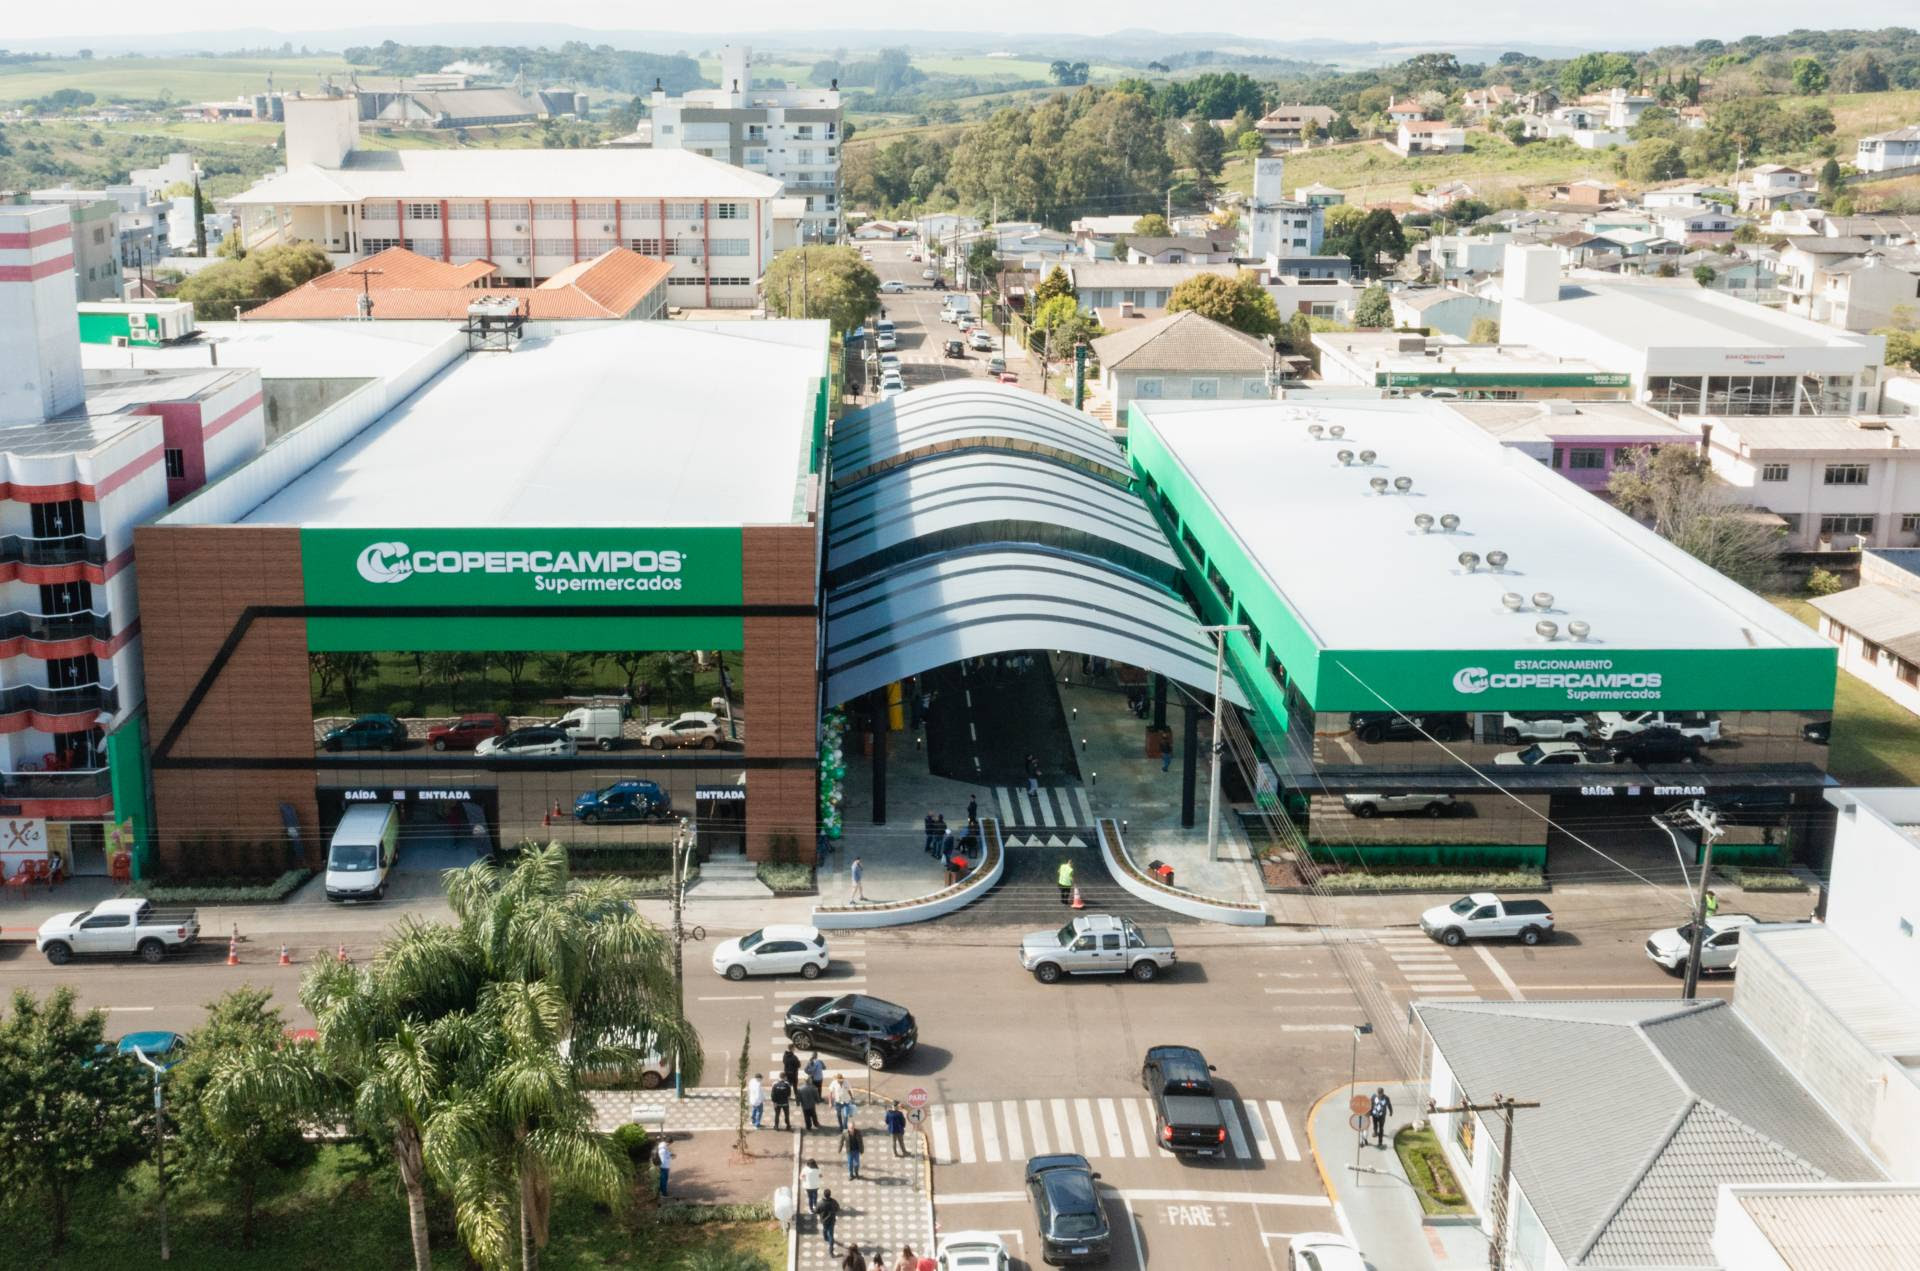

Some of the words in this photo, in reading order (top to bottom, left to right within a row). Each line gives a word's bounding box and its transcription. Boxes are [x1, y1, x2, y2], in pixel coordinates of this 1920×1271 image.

[412, 551, 682, 573] COPERCAMPOS
[535, 575, 682, 593] Supermercados
[1514, 660, 1613, 670] ESTACIONAMENTO
[1490, 673, 1662, 688] COPERCAMPOS
[1567, 688, 1661, 701] Supermercados
[344, 789, 377, 800] SAÍDA
[418, 790, 471, 800] ENTRADA
[695, 790, 746, 799] ENTRADA
[1581, 785, 1615, 796] SAÍDA
[1653, 786, 1706, 796] ENTRADA
[1167, 1205, 1217, 1227] PARE
